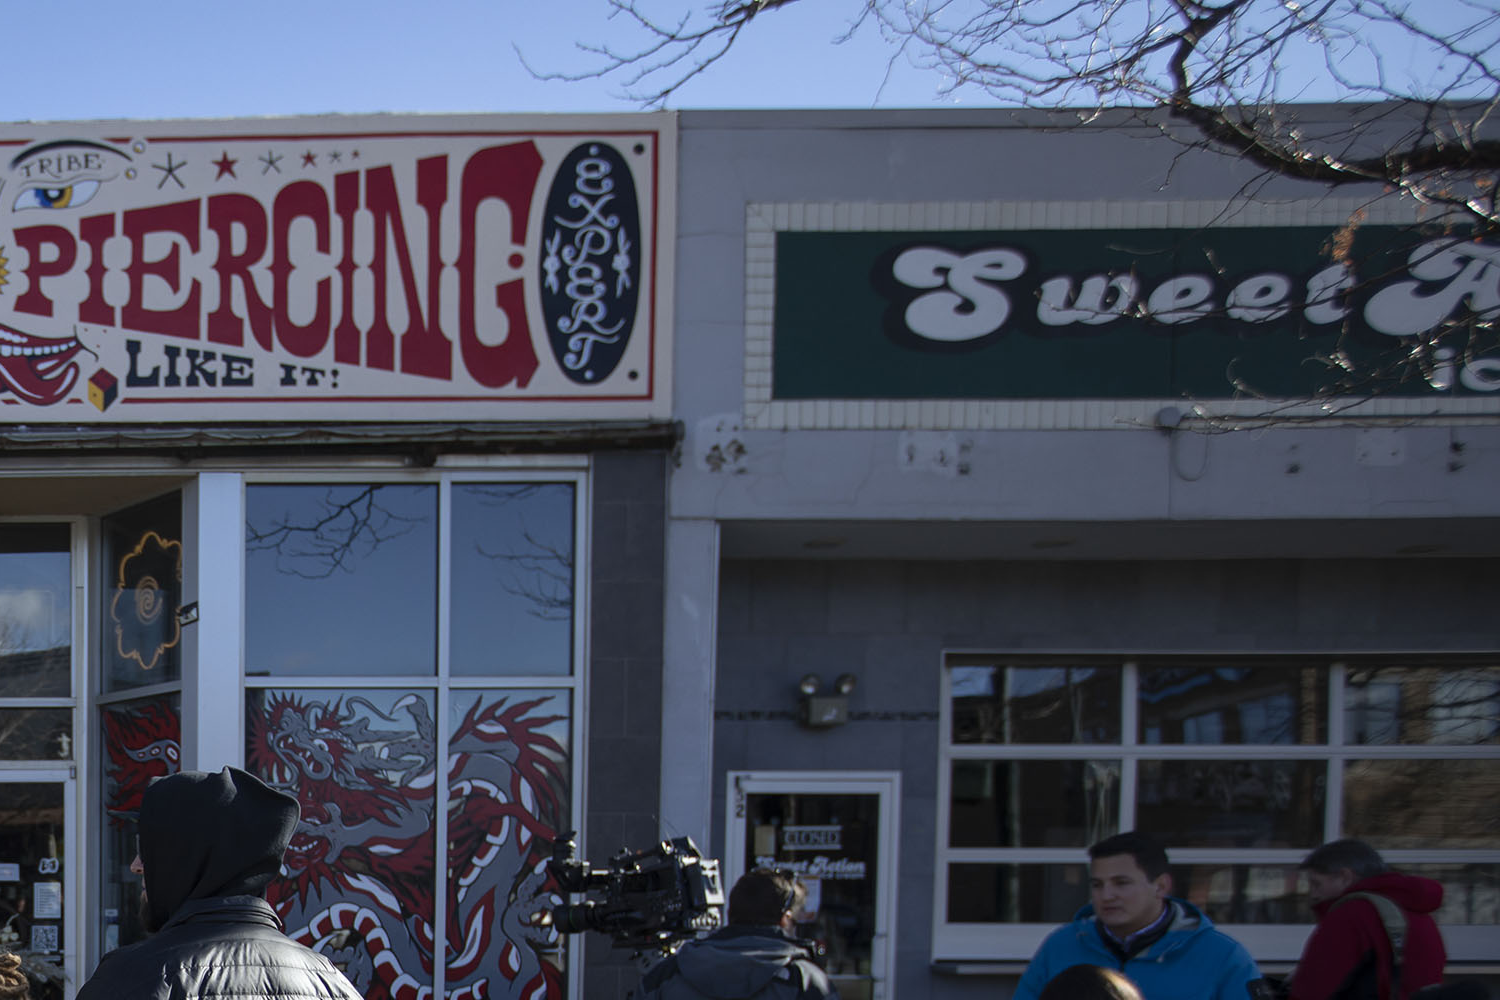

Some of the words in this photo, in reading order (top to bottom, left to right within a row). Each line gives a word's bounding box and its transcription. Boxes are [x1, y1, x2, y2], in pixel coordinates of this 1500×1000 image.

[21, 153, 102, 180] TRIBE
[12, 139, 544, 390] PIERCING
[554, 158, 626, 370] EXPERT
[892, 246, 1357, 342] Sweet
[125, 340, 254, 389] LIKE
[280, 362, 340, 390] IT!
